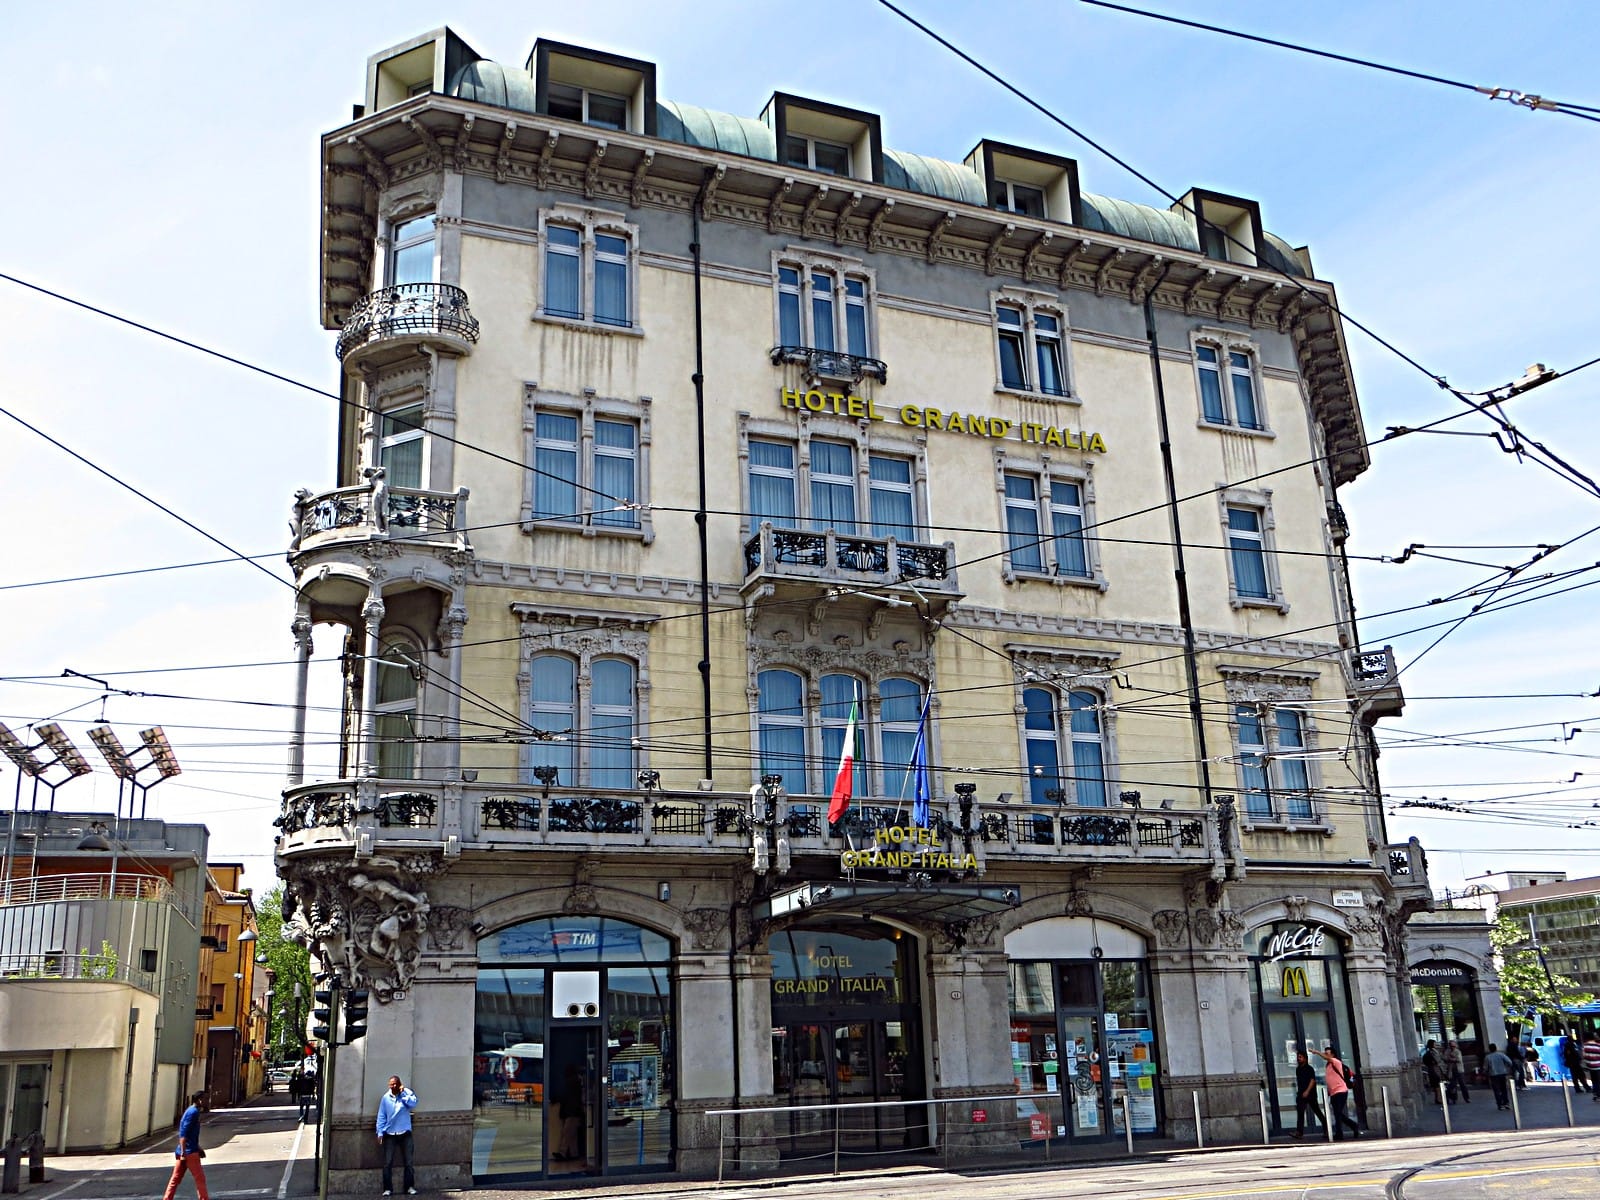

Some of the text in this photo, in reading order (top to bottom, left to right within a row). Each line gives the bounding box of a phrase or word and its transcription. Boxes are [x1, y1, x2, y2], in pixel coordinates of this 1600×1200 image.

[781, 386, 1107, 453] HOTEL GRAND' ITALIA
[875, 826, 942, 847] HOTEL
[921, 852, 978, 869] ITALIA
[571, 933, 596, 945] TIM
[812, 955, 853, 968] HOTEL
[1411, 967, 1463, 977] McDonald's
[840, 978, 886, 991] ITALIA
